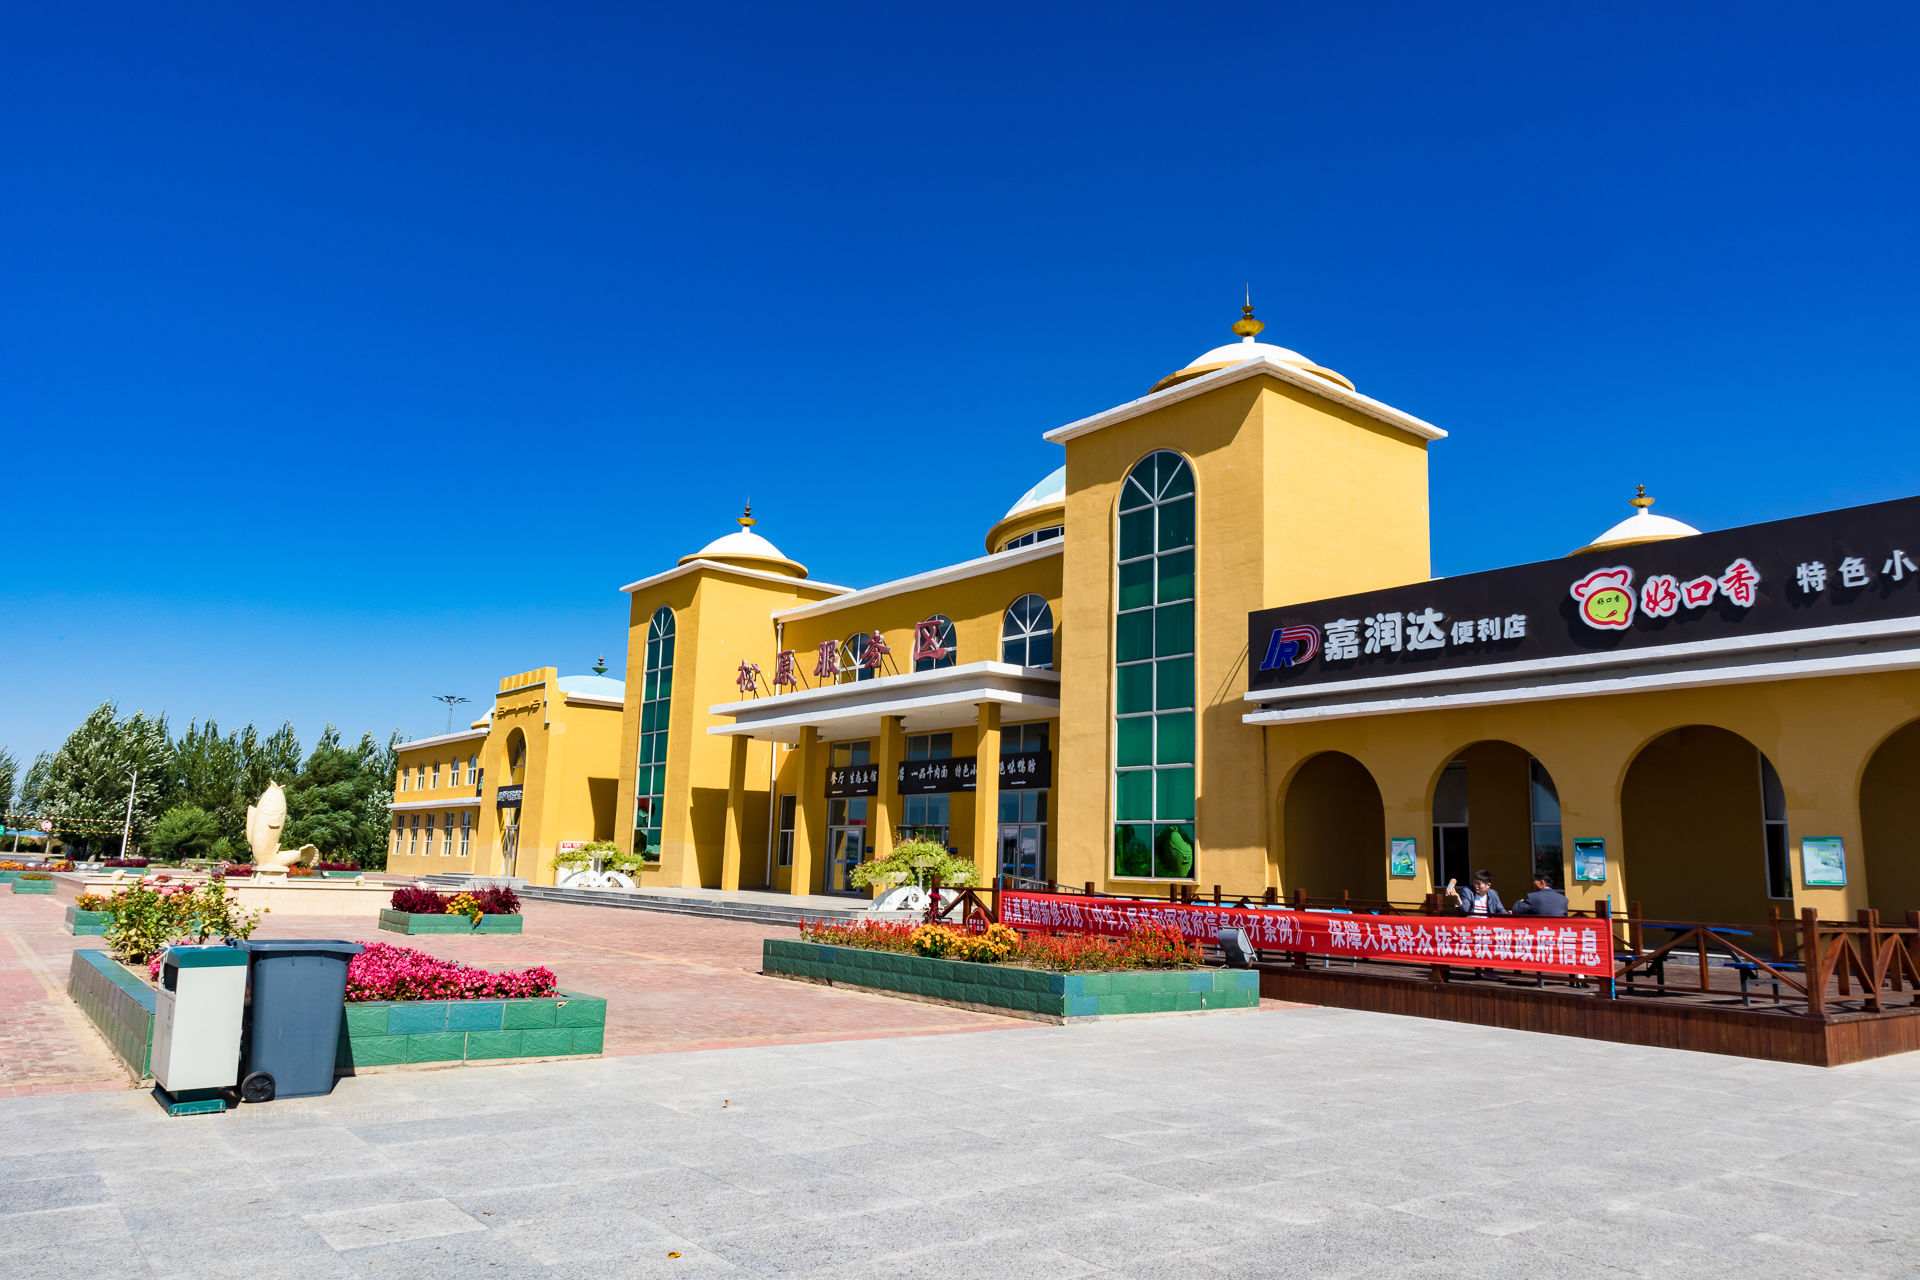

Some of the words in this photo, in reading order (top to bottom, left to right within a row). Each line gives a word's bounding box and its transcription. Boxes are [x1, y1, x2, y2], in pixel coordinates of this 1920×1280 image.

[1642, 560, 1760, 616] 好口香
[1796, 549, 1919, 594] 特色小
[736, 619, 949, 693] 松原服务区
[911, 763, 949, 781] 一品牛肉面
